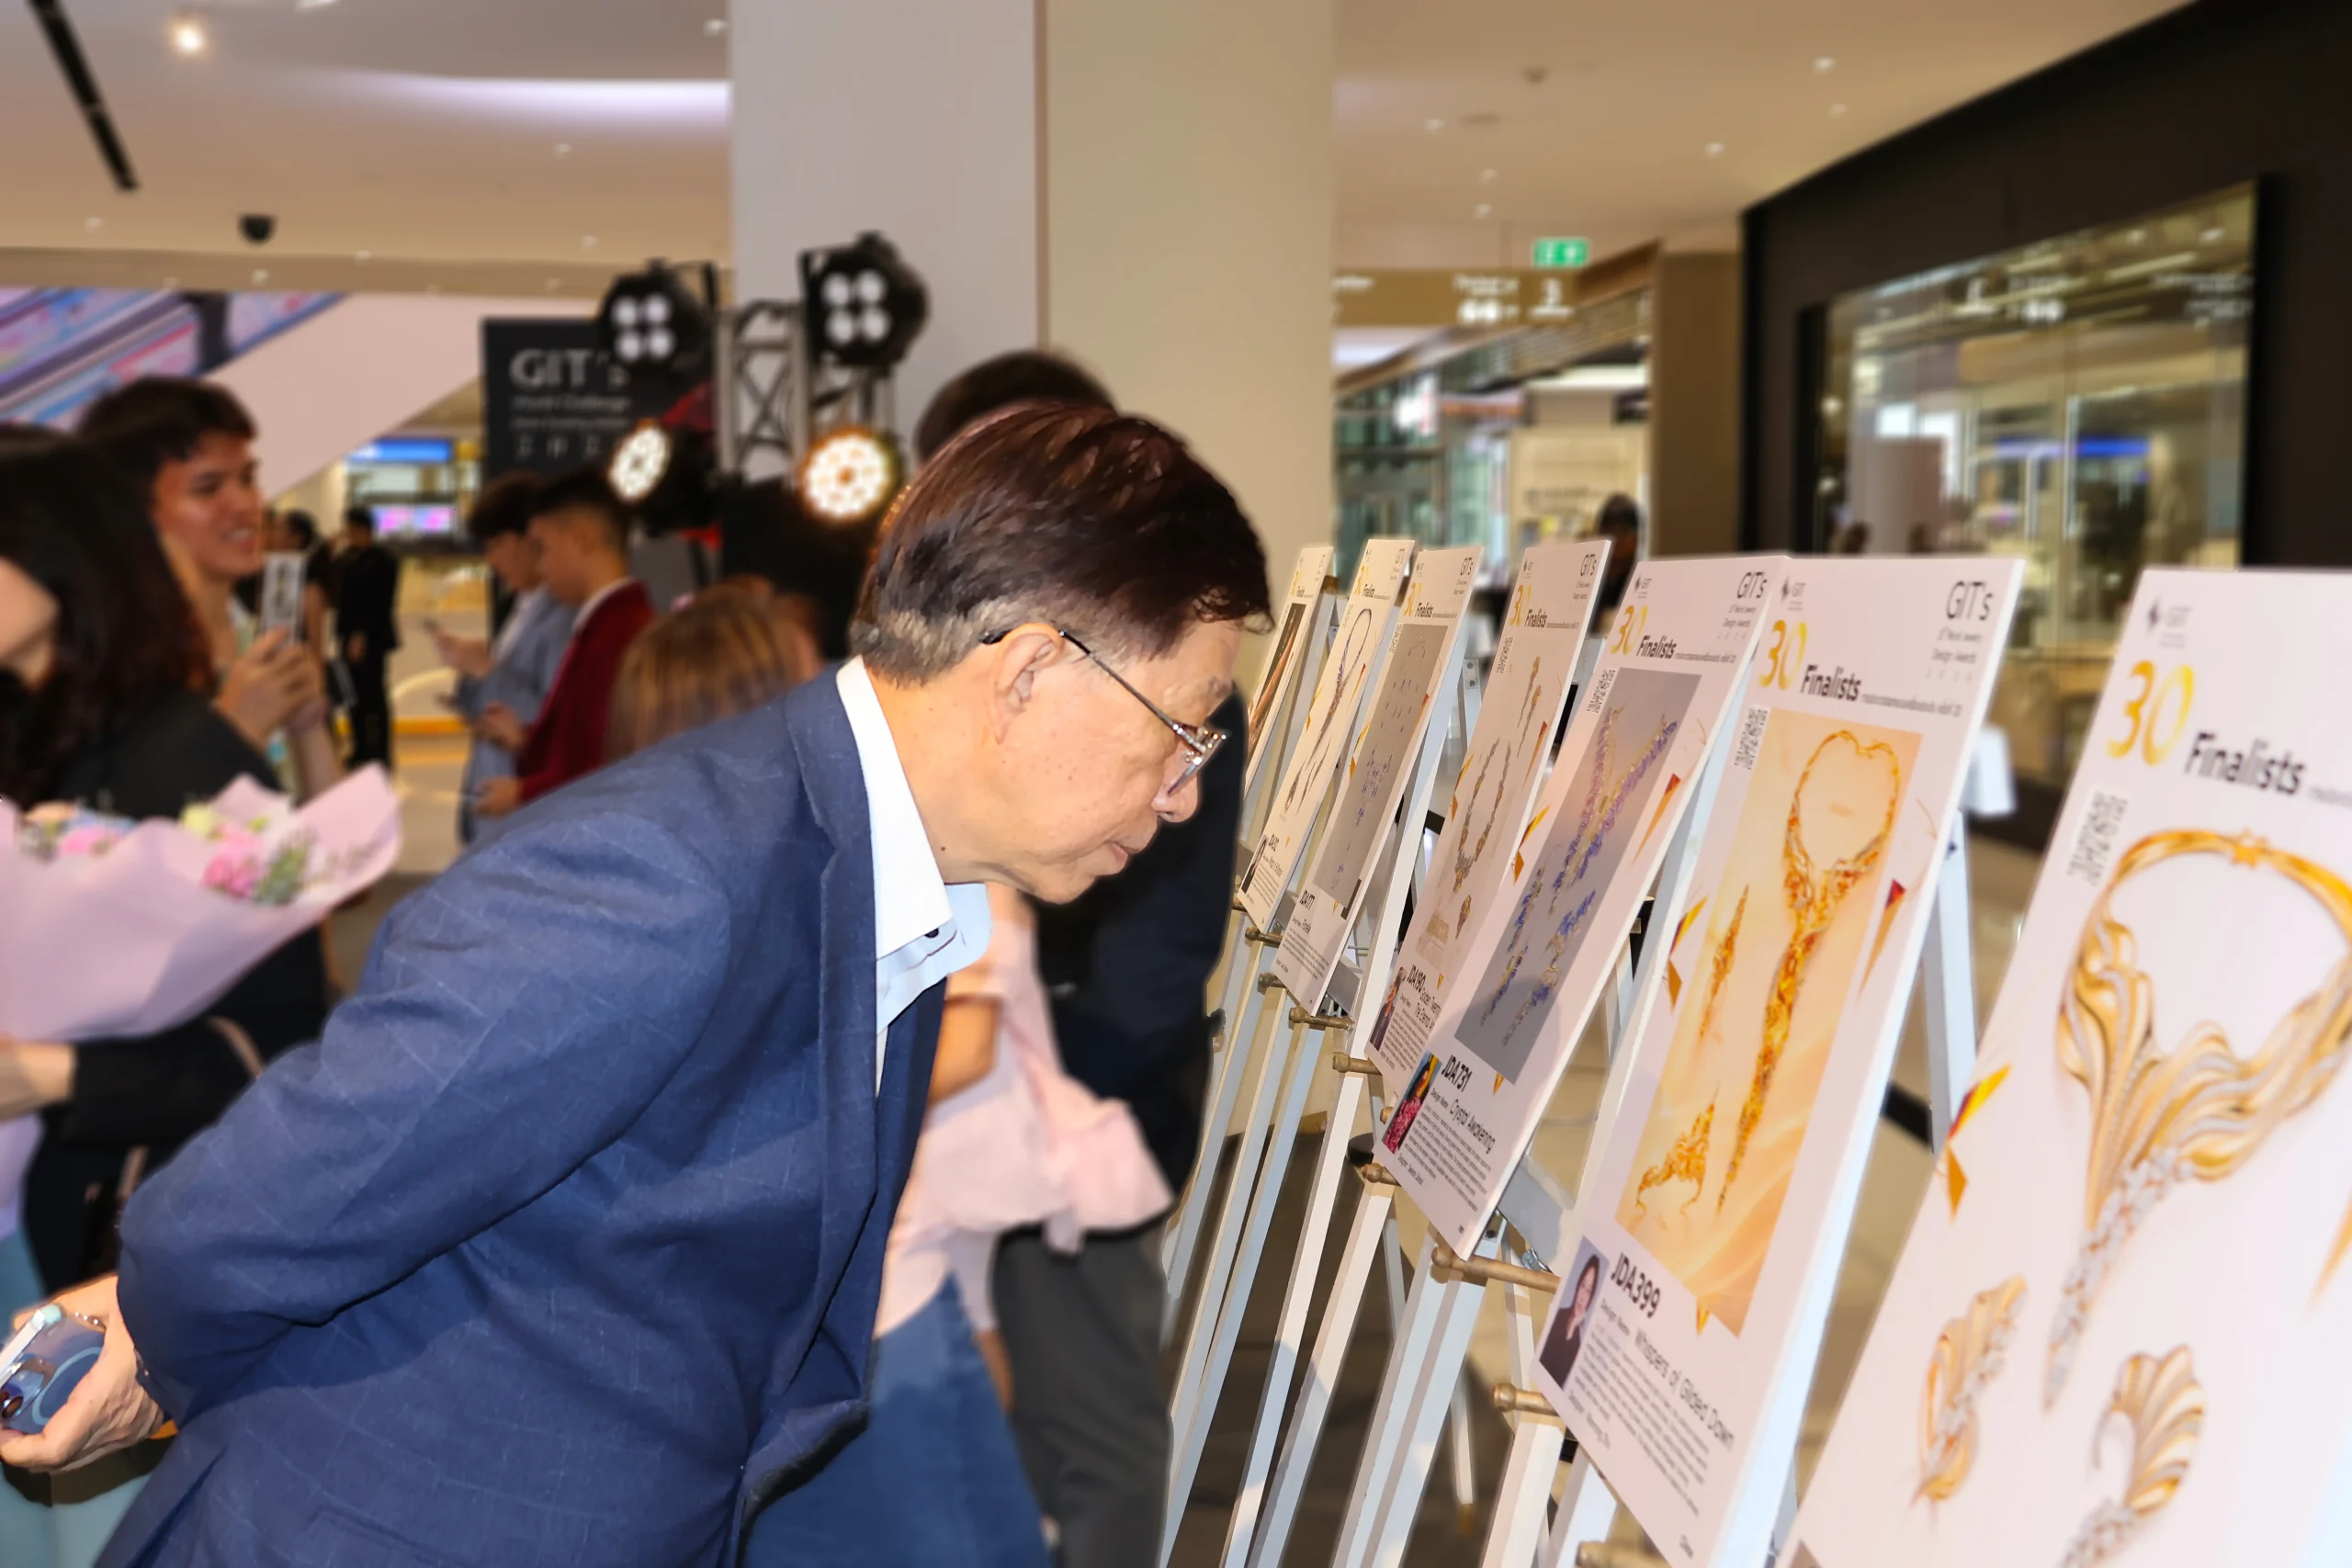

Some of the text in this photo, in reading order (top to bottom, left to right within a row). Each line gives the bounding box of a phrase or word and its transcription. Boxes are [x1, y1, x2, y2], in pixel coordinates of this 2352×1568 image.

[1580, 553, 1597, 577] GIT's
[1736, 571, 1768, 599] GIT's
[1509, 583, 1532, 626] 30
[1524, 608, 1548, 628] Finalists
[1946, 580, 1993, 621] GIT's
[1610, 604, 1648, 656] 30
[1636, 635, 1678, 660] Finalists
[1758, 618, 1808, 691] 30
[1800, 663, 1862, 702] Finalists
[2106, 660, 2196, 767] 30
[2184, 731, 2306, 796] Finalists
[1441, 1055, 1473, 1092] JDA731
[1611, 1252, 1661, 1319] JDA399
